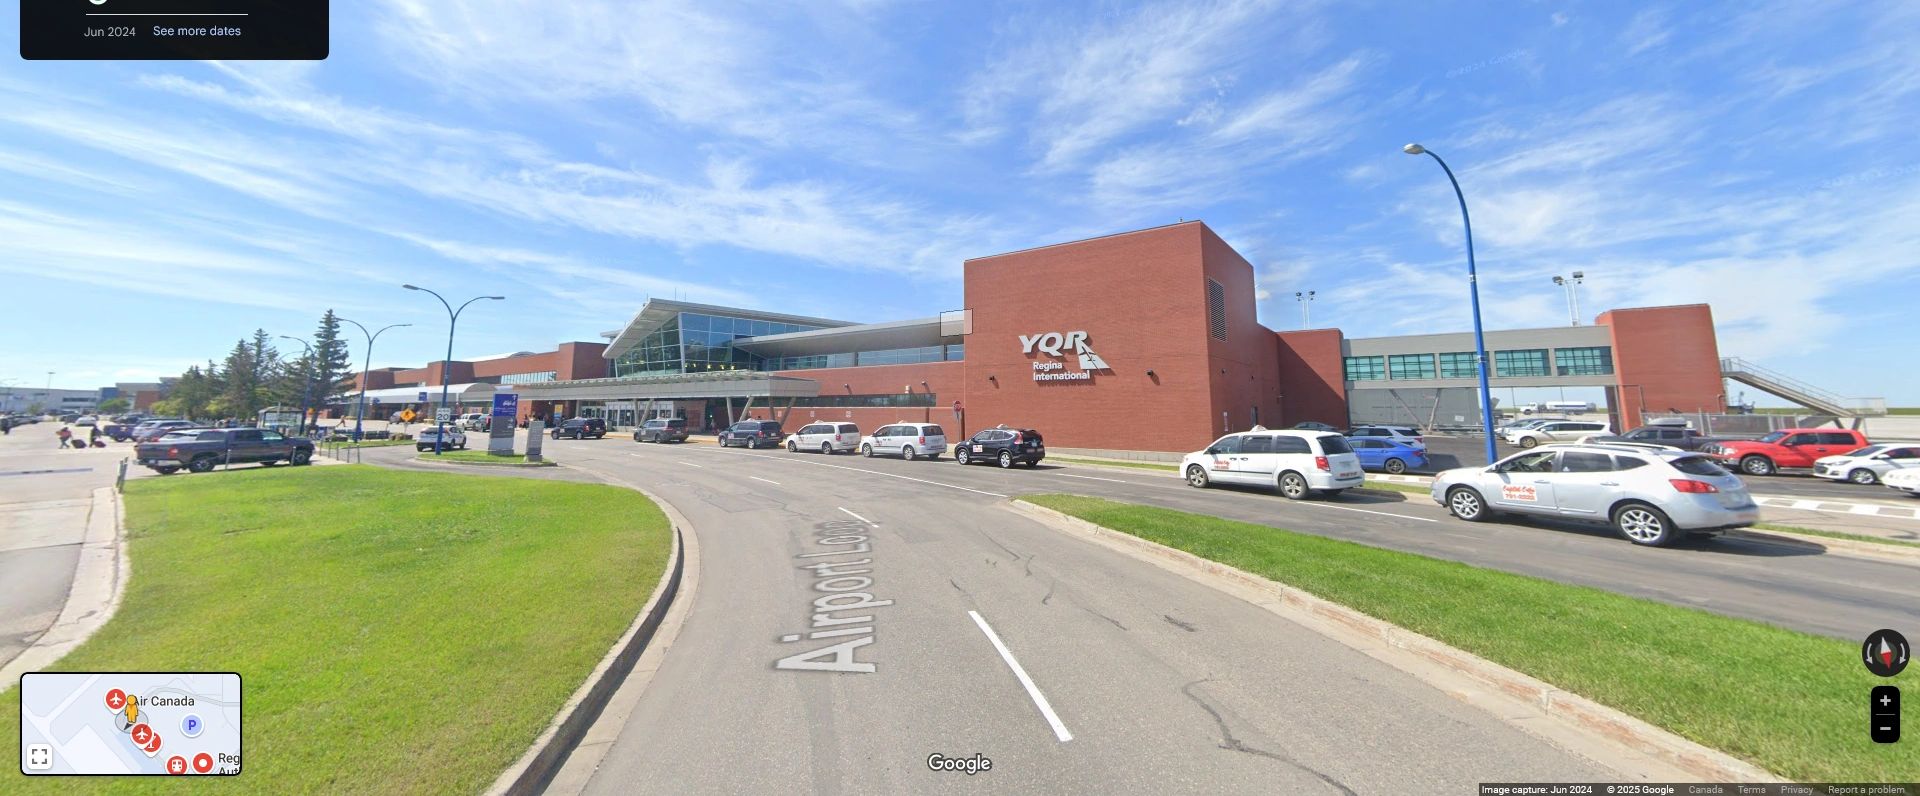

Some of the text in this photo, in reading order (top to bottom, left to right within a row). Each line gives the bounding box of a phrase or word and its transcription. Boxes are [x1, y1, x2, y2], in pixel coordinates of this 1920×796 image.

[1018, 330, 1110, 370] YQR
[1033, 361, 1063, 372] Regina
[1033, 370, 1091, 381] International
